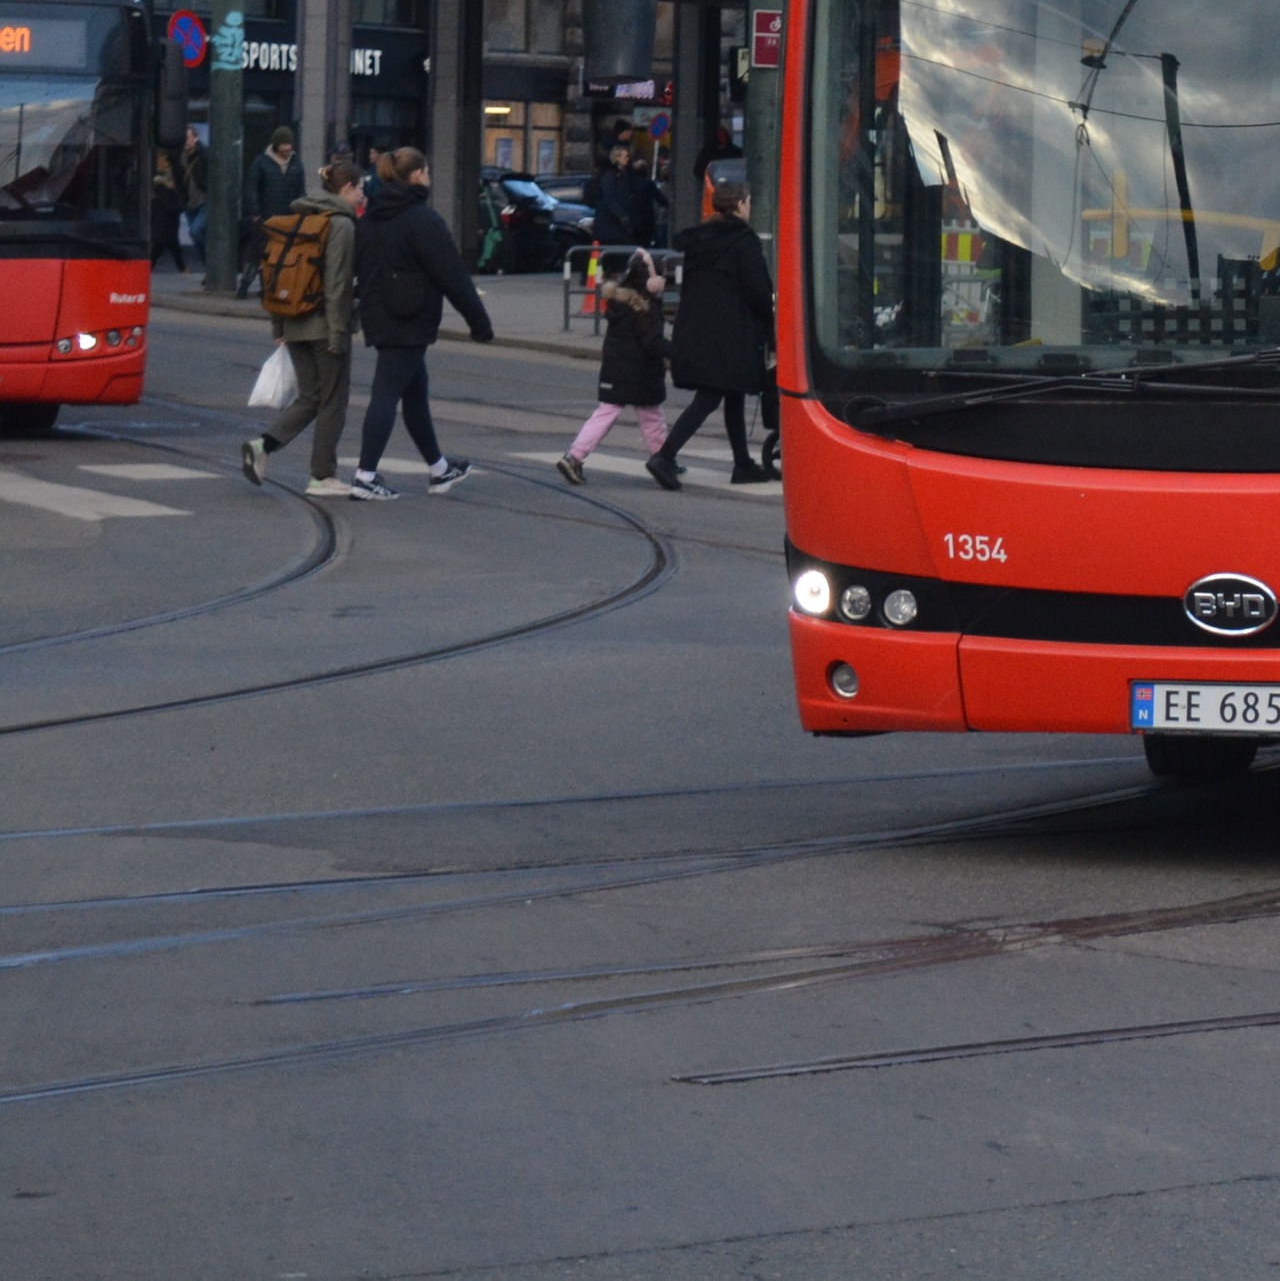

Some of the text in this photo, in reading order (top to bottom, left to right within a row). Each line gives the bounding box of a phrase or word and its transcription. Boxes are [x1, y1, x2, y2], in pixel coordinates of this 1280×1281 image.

[0, 26, 31, 53] en
[943, 533, 1008, 564] 1354
[1193, 592, 1266, 618] BYD
[1164, 690, 1201, 722] EE
